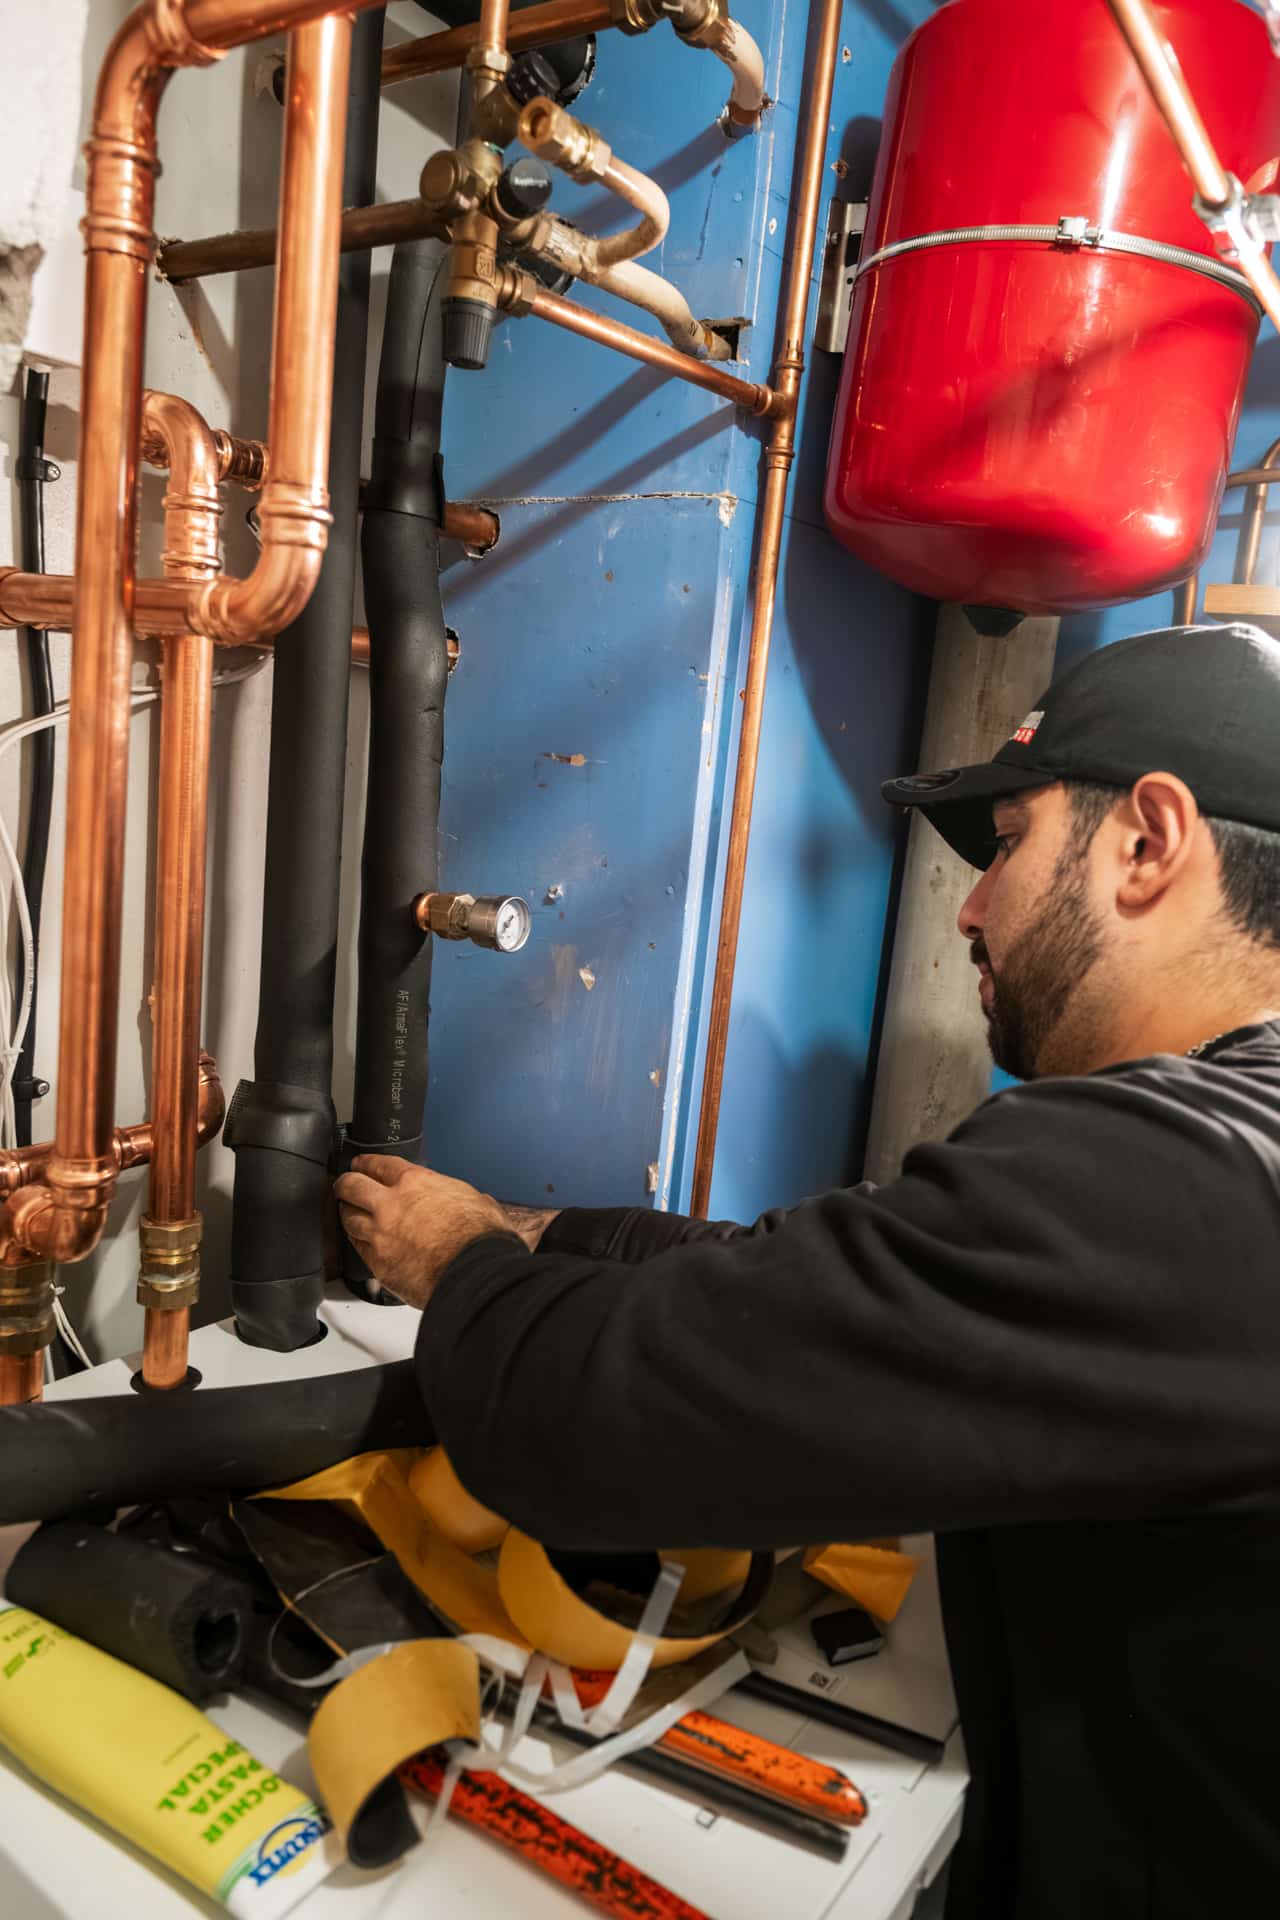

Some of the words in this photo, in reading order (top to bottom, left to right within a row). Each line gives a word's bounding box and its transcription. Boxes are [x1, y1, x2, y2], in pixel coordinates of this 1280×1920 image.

[157, 1740, 243, 1812] PECIAL
[187, 1758, 263, 1815] PASTA
[202, 1774, 281, 1845] OCHER
